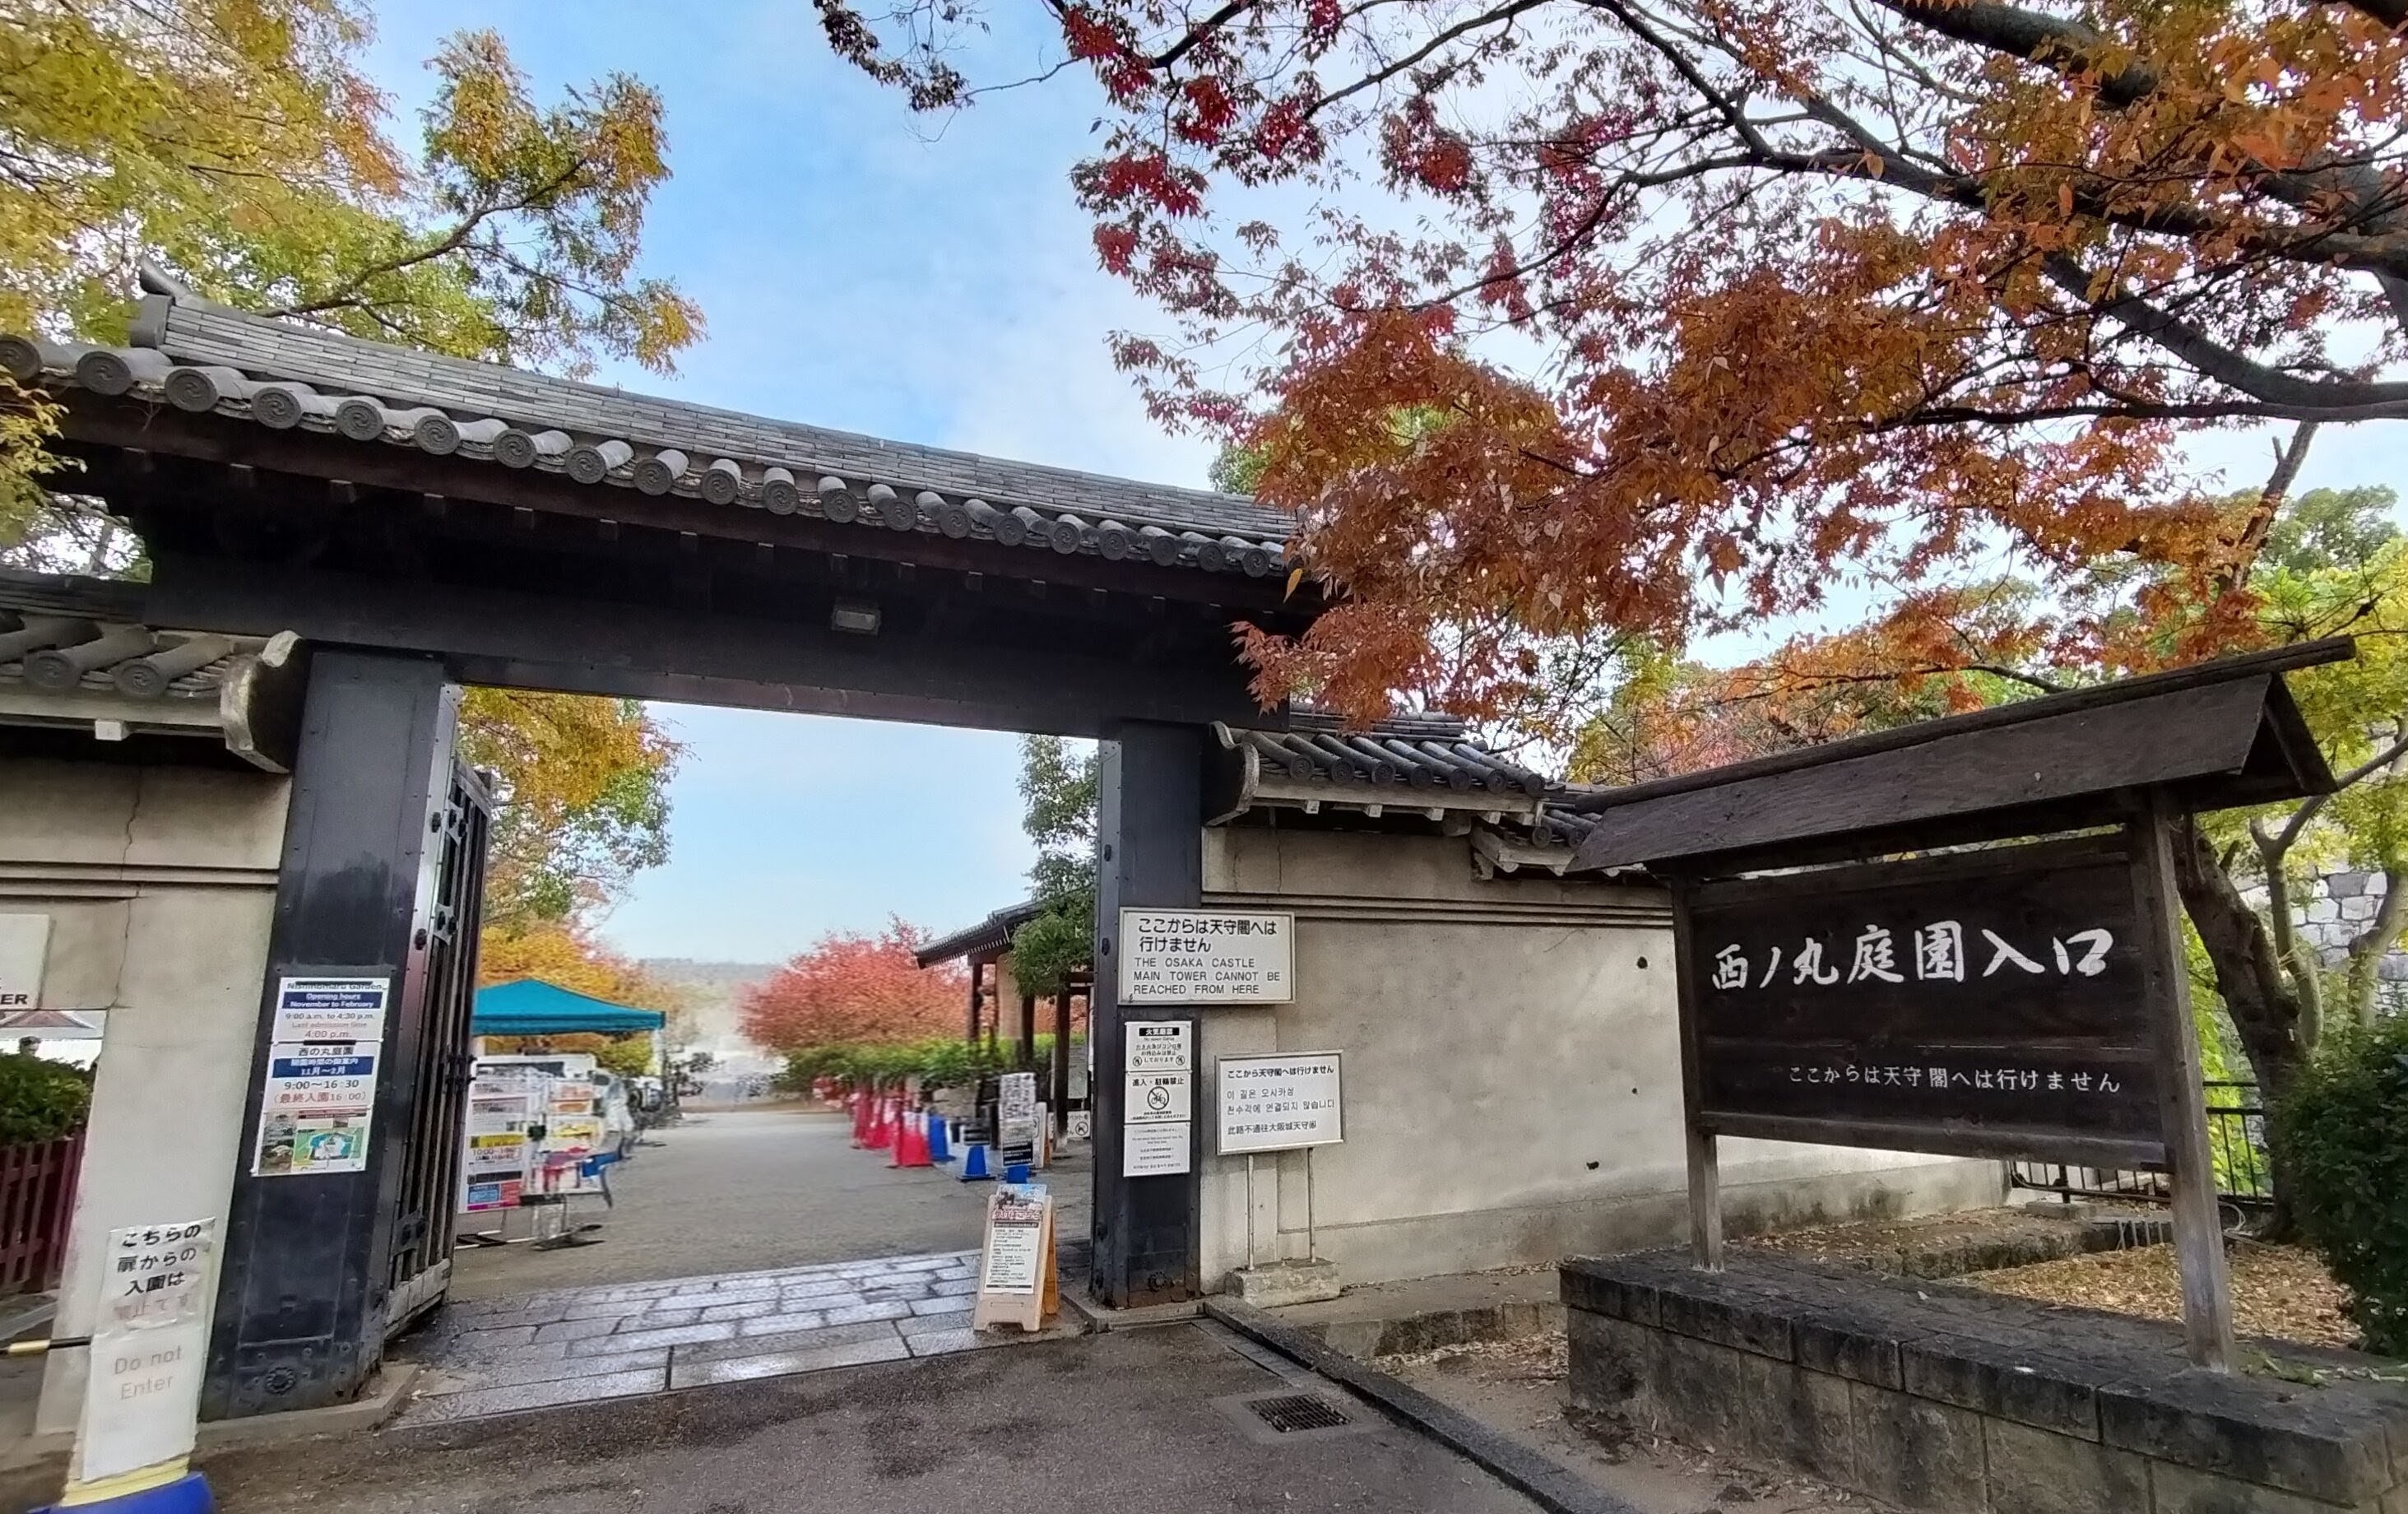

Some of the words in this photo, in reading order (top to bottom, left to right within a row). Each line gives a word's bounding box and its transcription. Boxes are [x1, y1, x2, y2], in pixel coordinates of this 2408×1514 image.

[1139, 917, 1277, 936] ここからは天守閣へは
[1139, 936, 1212, 953] 行けません
[1134, 957, 1157, 968] THE
[1165, 957, 1204, 968] OSAKA
[1211, 958, 1255, 968] CASTLE
[1712, 920, 2114, 990] 西ノ丸庭園入口
[1134, 971, 1161, 981] MAIN
[1169, 971, 1207, 981] TOWER
[1215, 971, 1259, 981] CANNOT
[1267, 971, 1280, 981] BE
[340, 992, 361, 1001] hours
[1134, 984, 1186, 995] REACHED
[1194, 984, 1225, 994] FROM
[1232, 984, 1260, 994] HERE
[304, 1030, 327, 1038] 4:00
[1227, 1065, 1334, 1080] ここから天守閣へは行けません
[1789, 1065, 2120, 1093] ここからは天守閣へは行けません
[1227, 1090, 1235, 1100] 이
[122, 1224, 202, 1248] こちらの
[117, 1247, 197, 1273] 扉からの
[124, 1271, 185, 1297] 入園は
[114, 1358, 142, 1375] Do
[151, 1344, 183, 1367] not
[120, 1375, 174, 1400] Enter
